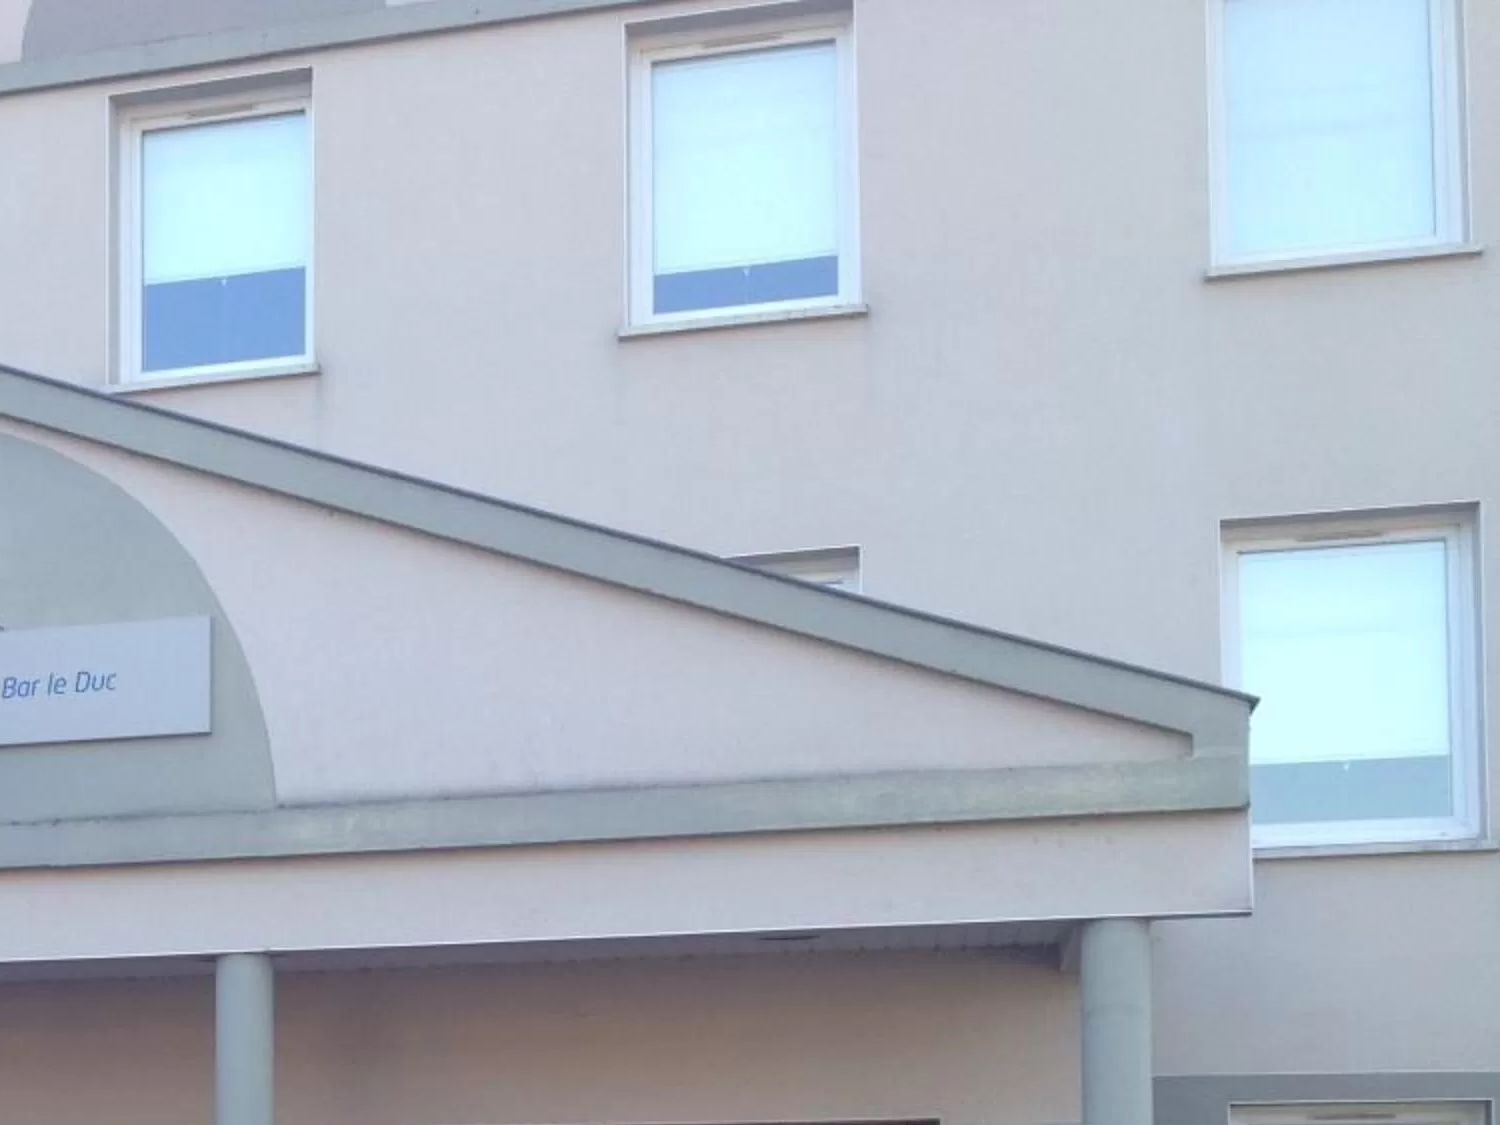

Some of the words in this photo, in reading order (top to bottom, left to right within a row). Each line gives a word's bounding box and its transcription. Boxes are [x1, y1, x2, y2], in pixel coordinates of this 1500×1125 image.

[1, 675, 41, 699] Bar
[47, 671, 67, 697] le
[75, 670, 117, 693] Duc
